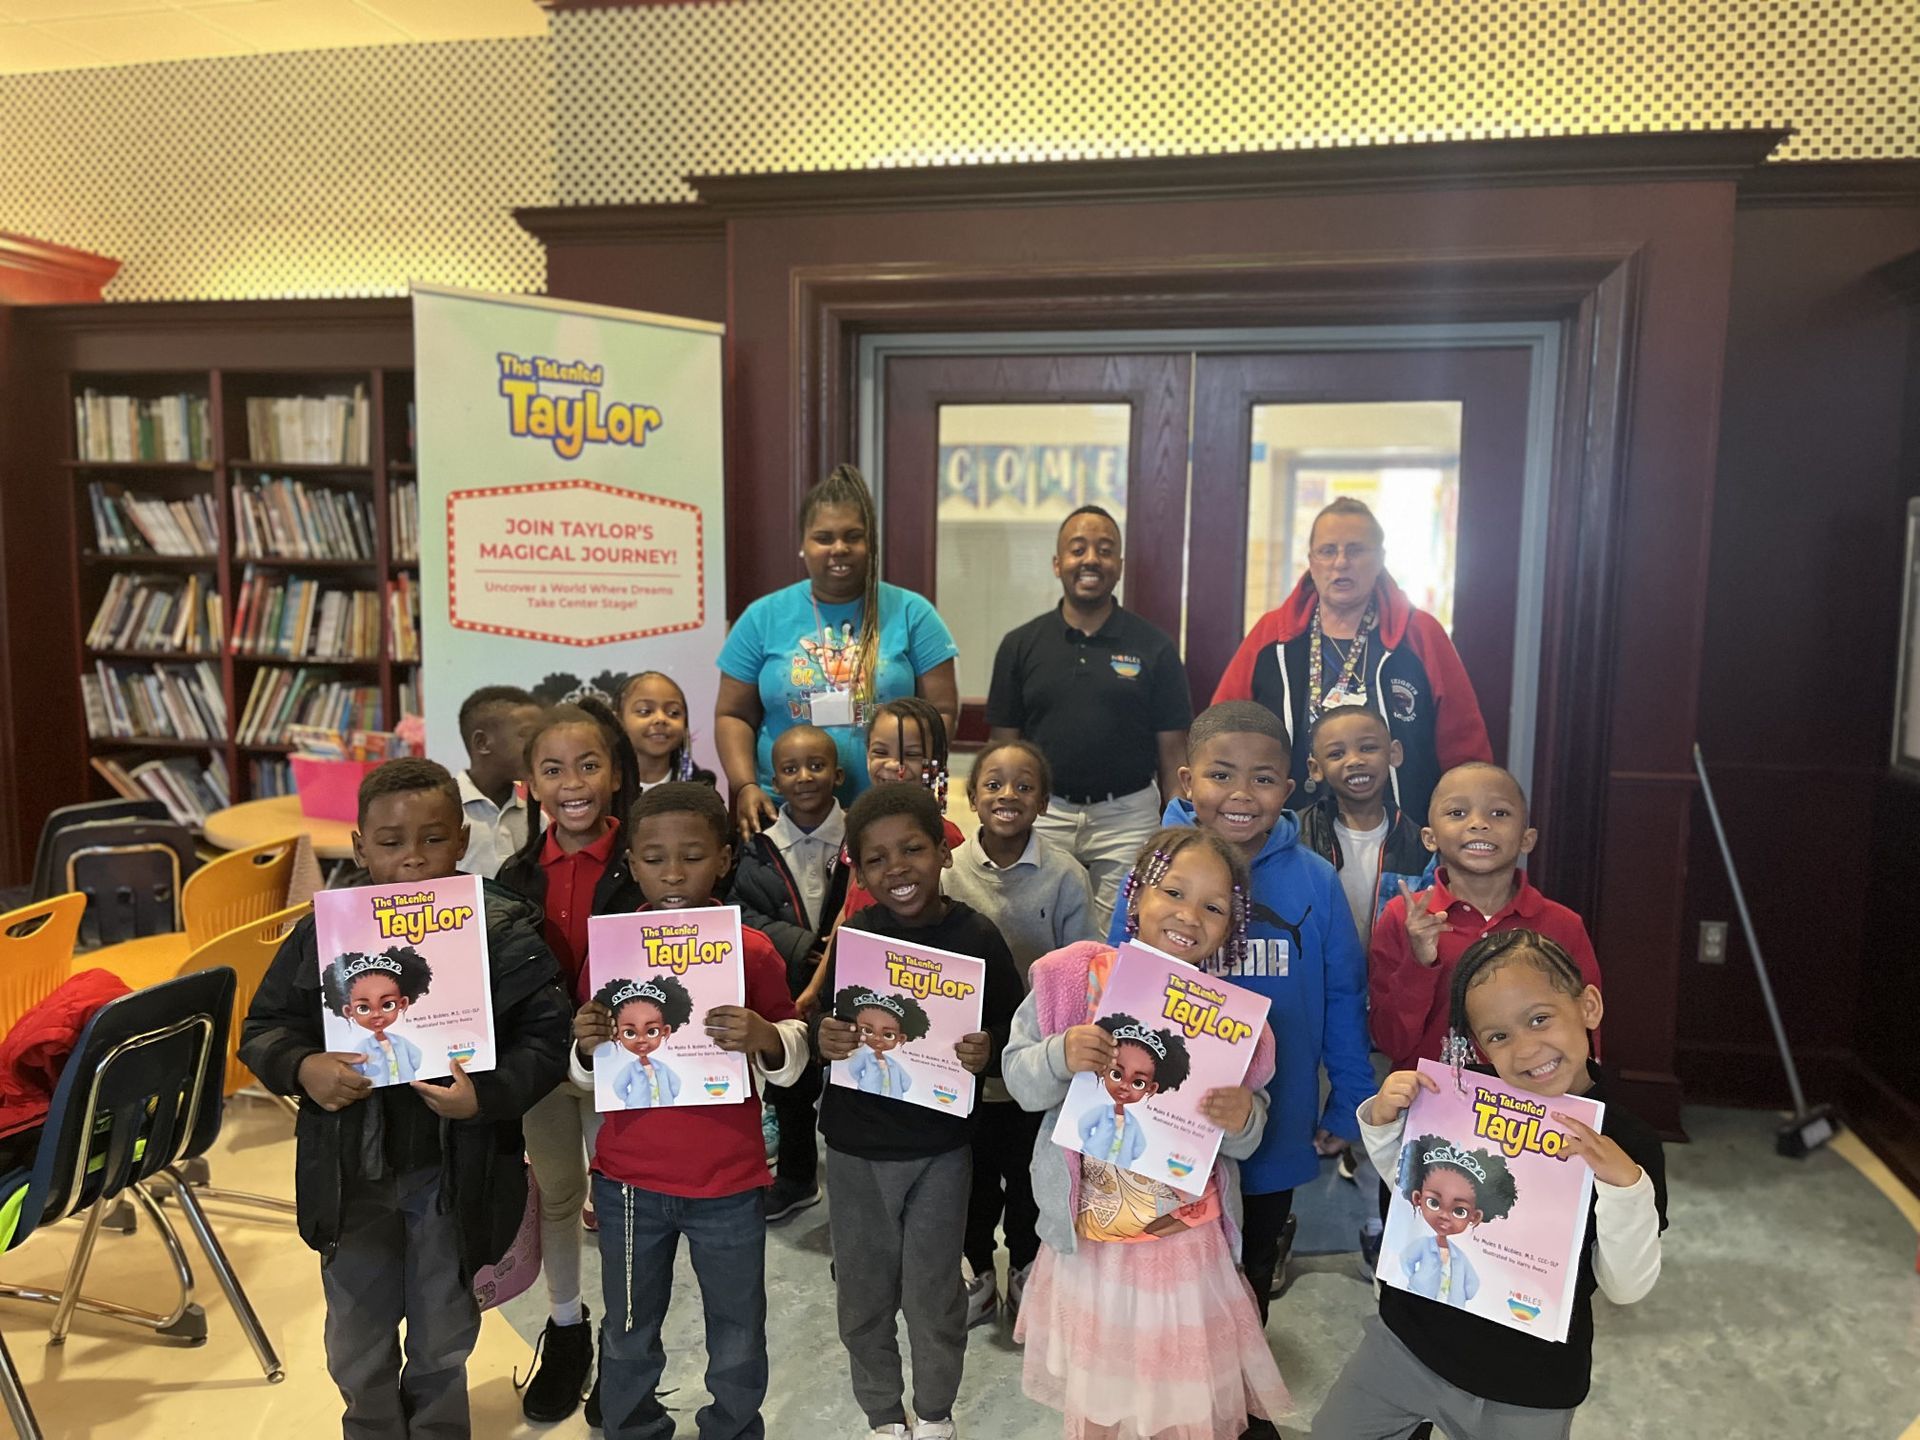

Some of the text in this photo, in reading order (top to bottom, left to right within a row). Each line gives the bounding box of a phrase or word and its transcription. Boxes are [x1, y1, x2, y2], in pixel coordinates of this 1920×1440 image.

[500, 353, 533, 380] The
[506, 518, 654, 540] JOIN TAYLOR'S
[480, 543, 677, 565] MAGICAL JOURNEY!
[485, 582, 673, 596] Uncover a World Where Dreams
[527, 597, 637, 611] Take Center Stage!
[373, 897, 392, 909] The
[641, 926, 660, 938] The
[886, 951, 903, 964] The
[1200, 939, 1289, 976] UMA
[1169, 973, 1187, 990] The
[1475, 1087, 1497, 1104] The
